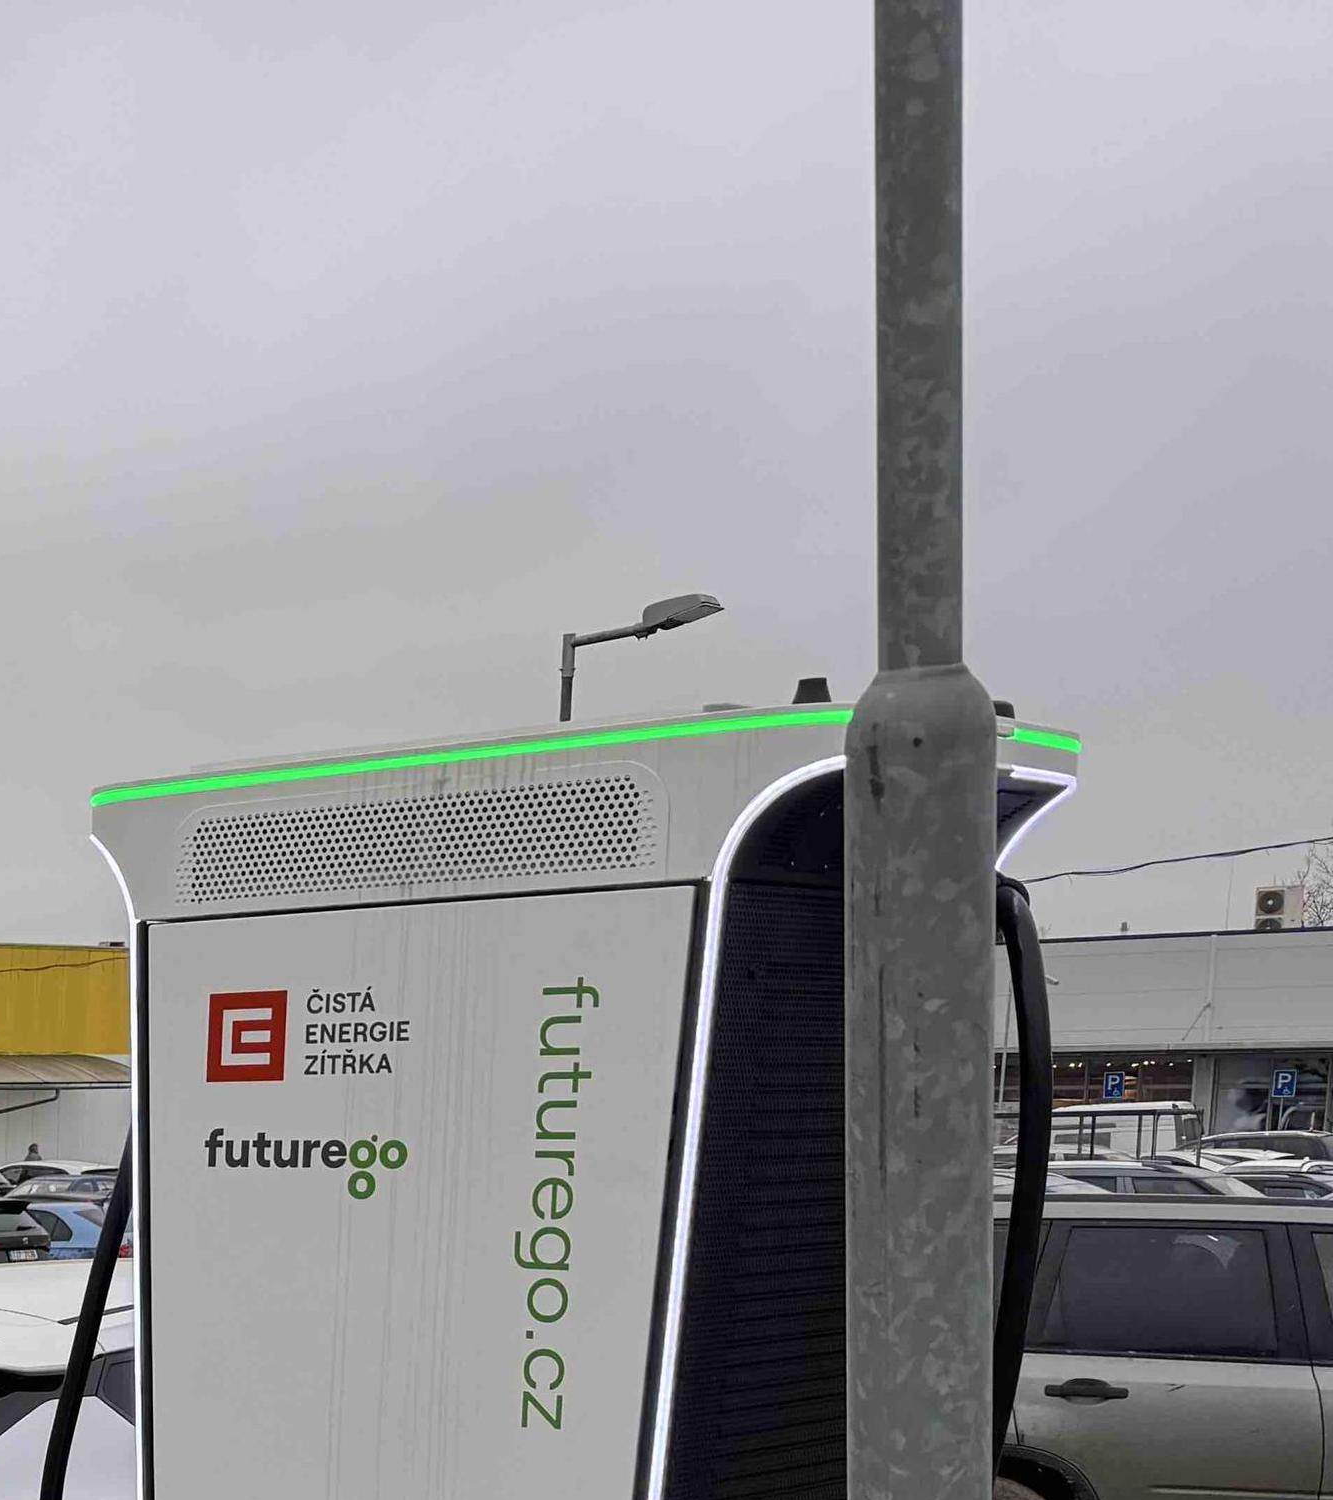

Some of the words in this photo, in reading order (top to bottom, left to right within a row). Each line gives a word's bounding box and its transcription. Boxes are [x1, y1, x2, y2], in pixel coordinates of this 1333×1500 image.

[306, 986, 376, 1014] ČISTÁ
[304, 1020, 410, 1044] ENERGIE
[304, 1051, 393, 1076] ZÍTŘKA
[1107, 1074, 1120, 1090] P
[1277, 1073, 1292, 1089] P
[204, 1128, 408, 1199] futurego
[513, 976, 600, 1430] futurego.cz
